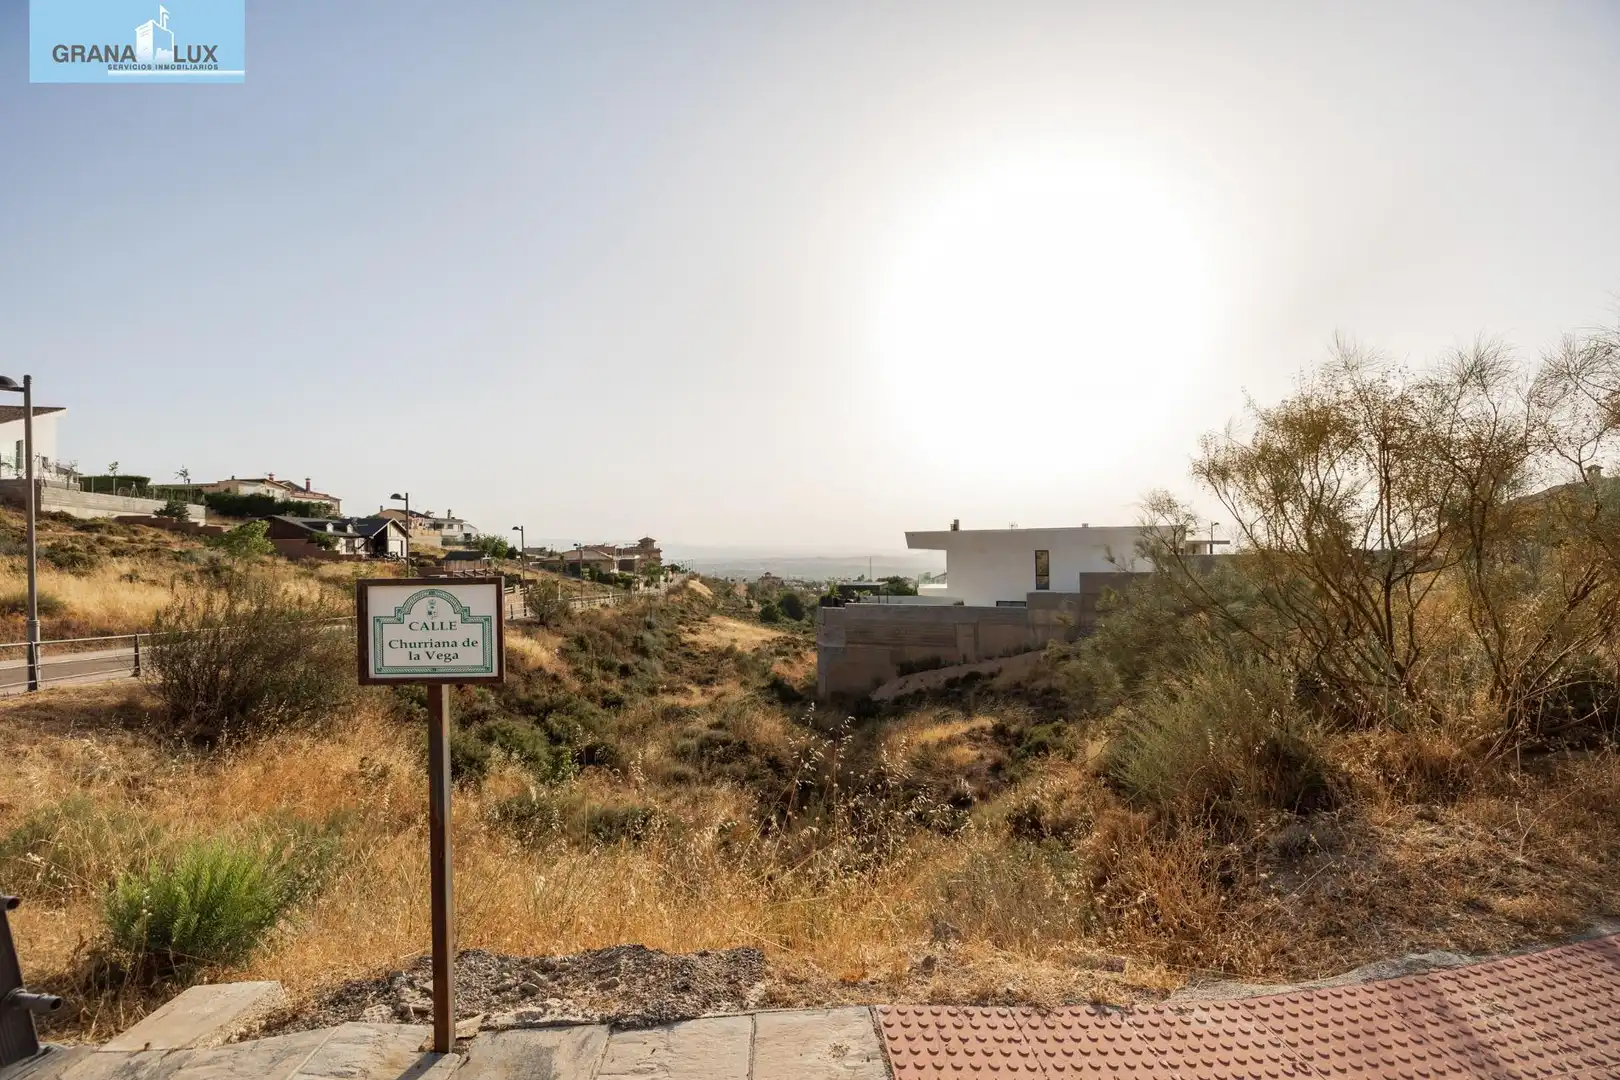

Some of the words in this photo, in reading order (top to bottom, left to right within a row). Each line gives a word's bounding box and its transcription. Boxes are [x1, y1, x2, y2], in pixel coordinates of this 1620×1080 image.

[408, 621, 458, 631] CALLE
[388, 638, 458, 649] Churriana
[461, 638, 479, 648] de
[408, 651, 421, 661] la
[424, 651, 459, 663] Vega
